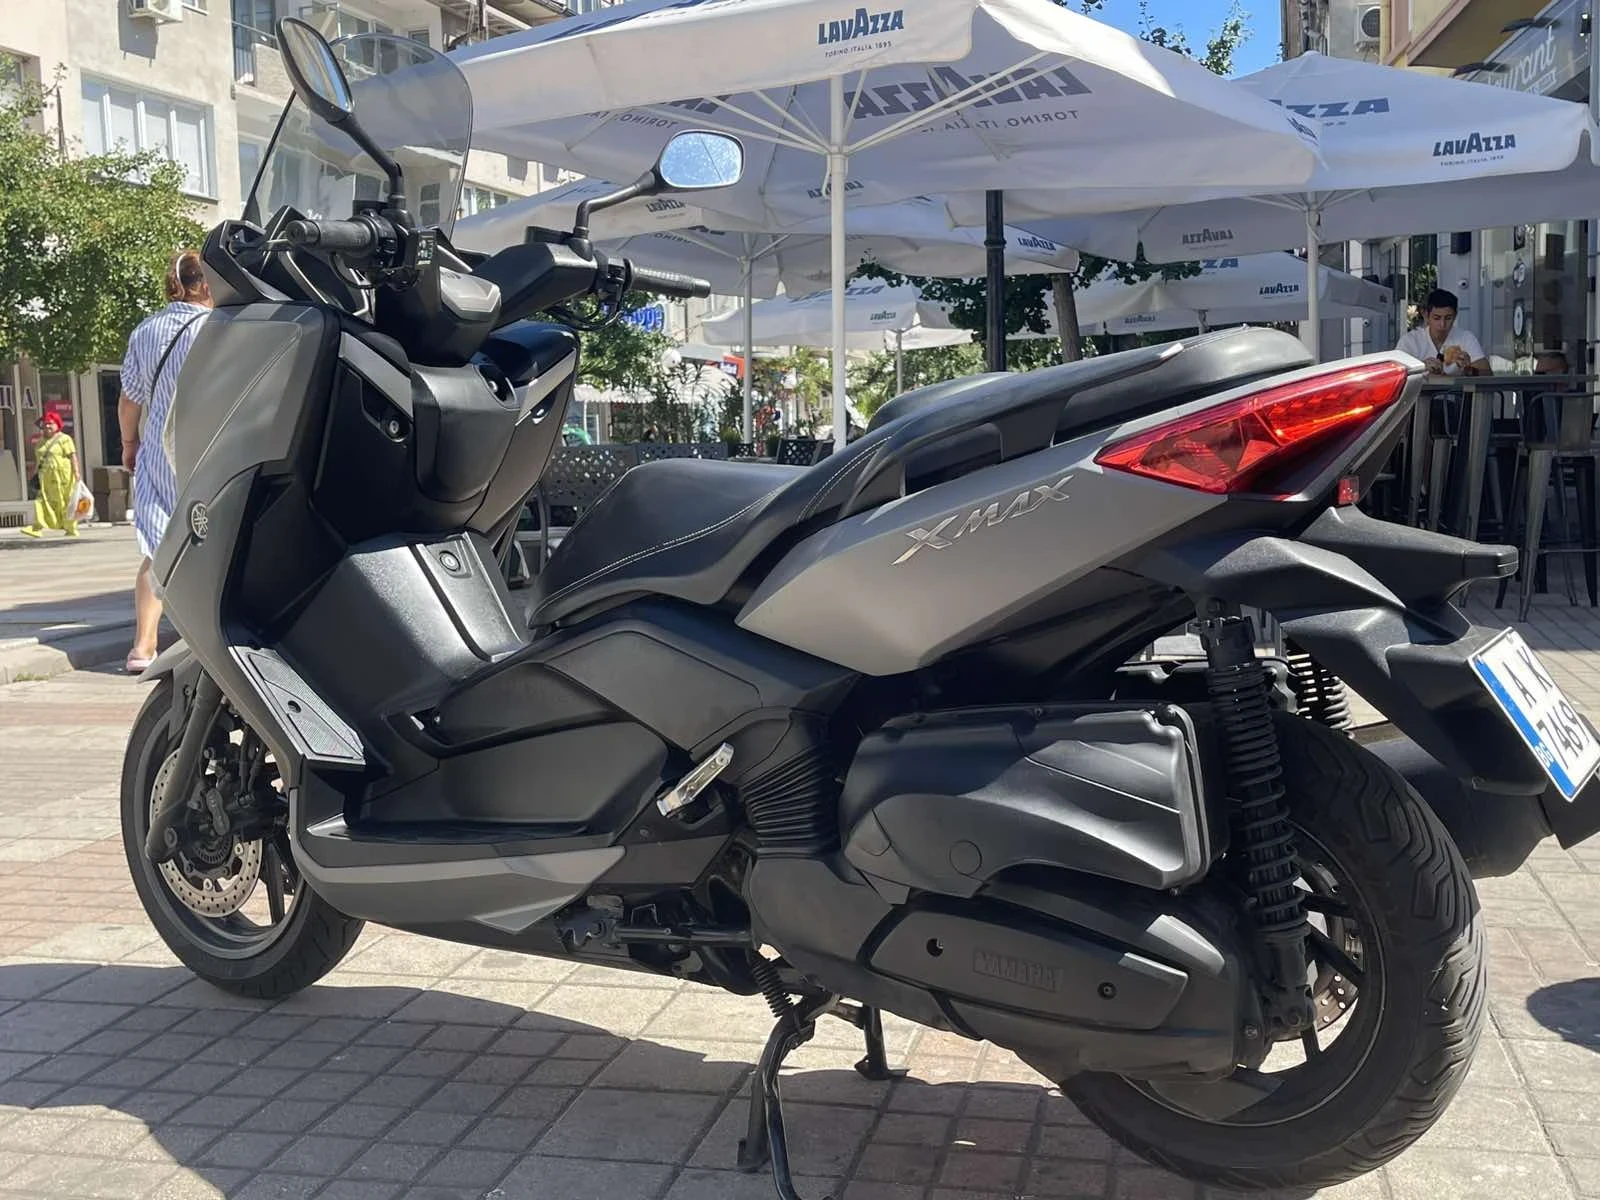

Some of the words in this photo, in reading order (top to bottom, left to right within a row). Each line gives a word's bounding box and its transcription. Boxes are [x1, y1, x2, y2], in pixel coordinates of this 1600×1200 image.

[818, 8, 904, 45] LAVAZZA
[1433, 132, 1516, 156] LAVAZZA
[1535, 699, 1590, 770] 7469
